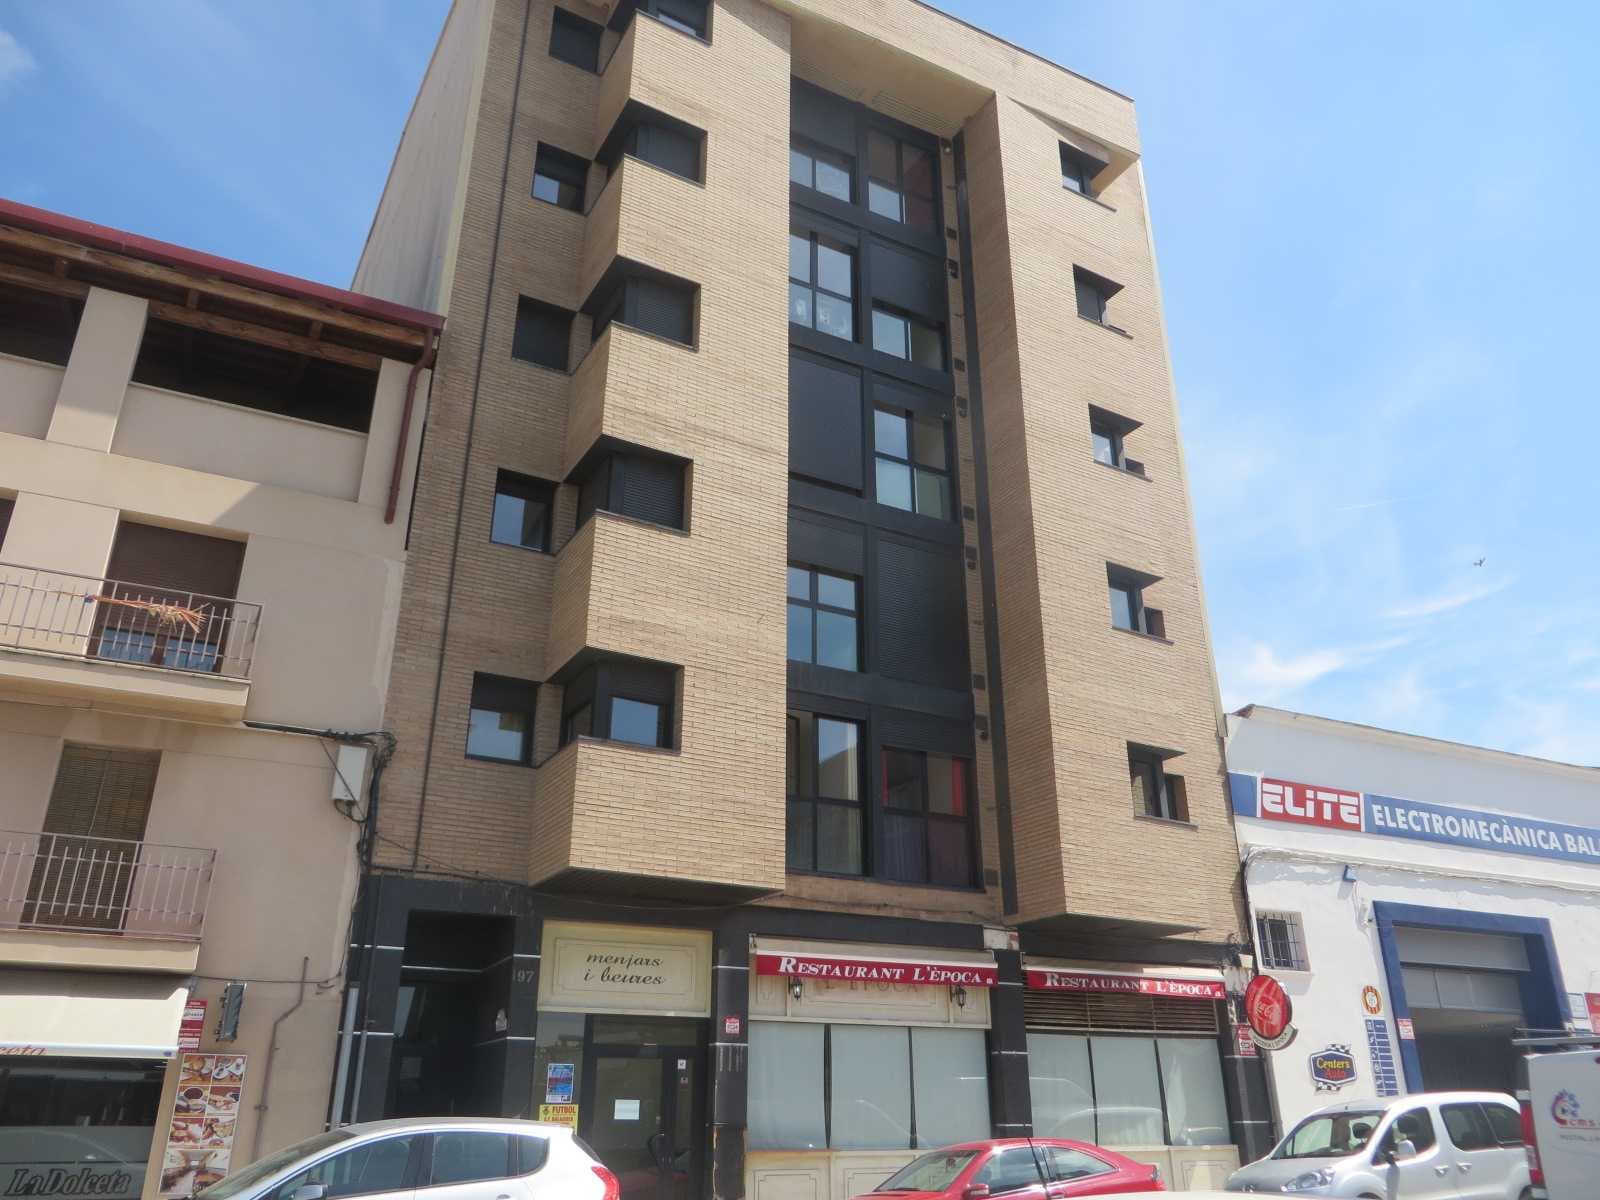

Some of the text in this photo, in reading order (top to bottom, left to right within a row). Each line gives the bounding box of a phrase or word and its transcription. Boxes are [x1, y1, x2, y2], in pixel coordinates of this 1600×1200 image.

[1372, 804, 1561, 852] ELECTROMECÀNICA
[586, 953, 663, 970] menjars
[779, 956, 904, 980] RESTAURANT
[584, 966, 666, 985] i beures
[1044, 973, 1150, 993] RESTAURANT
